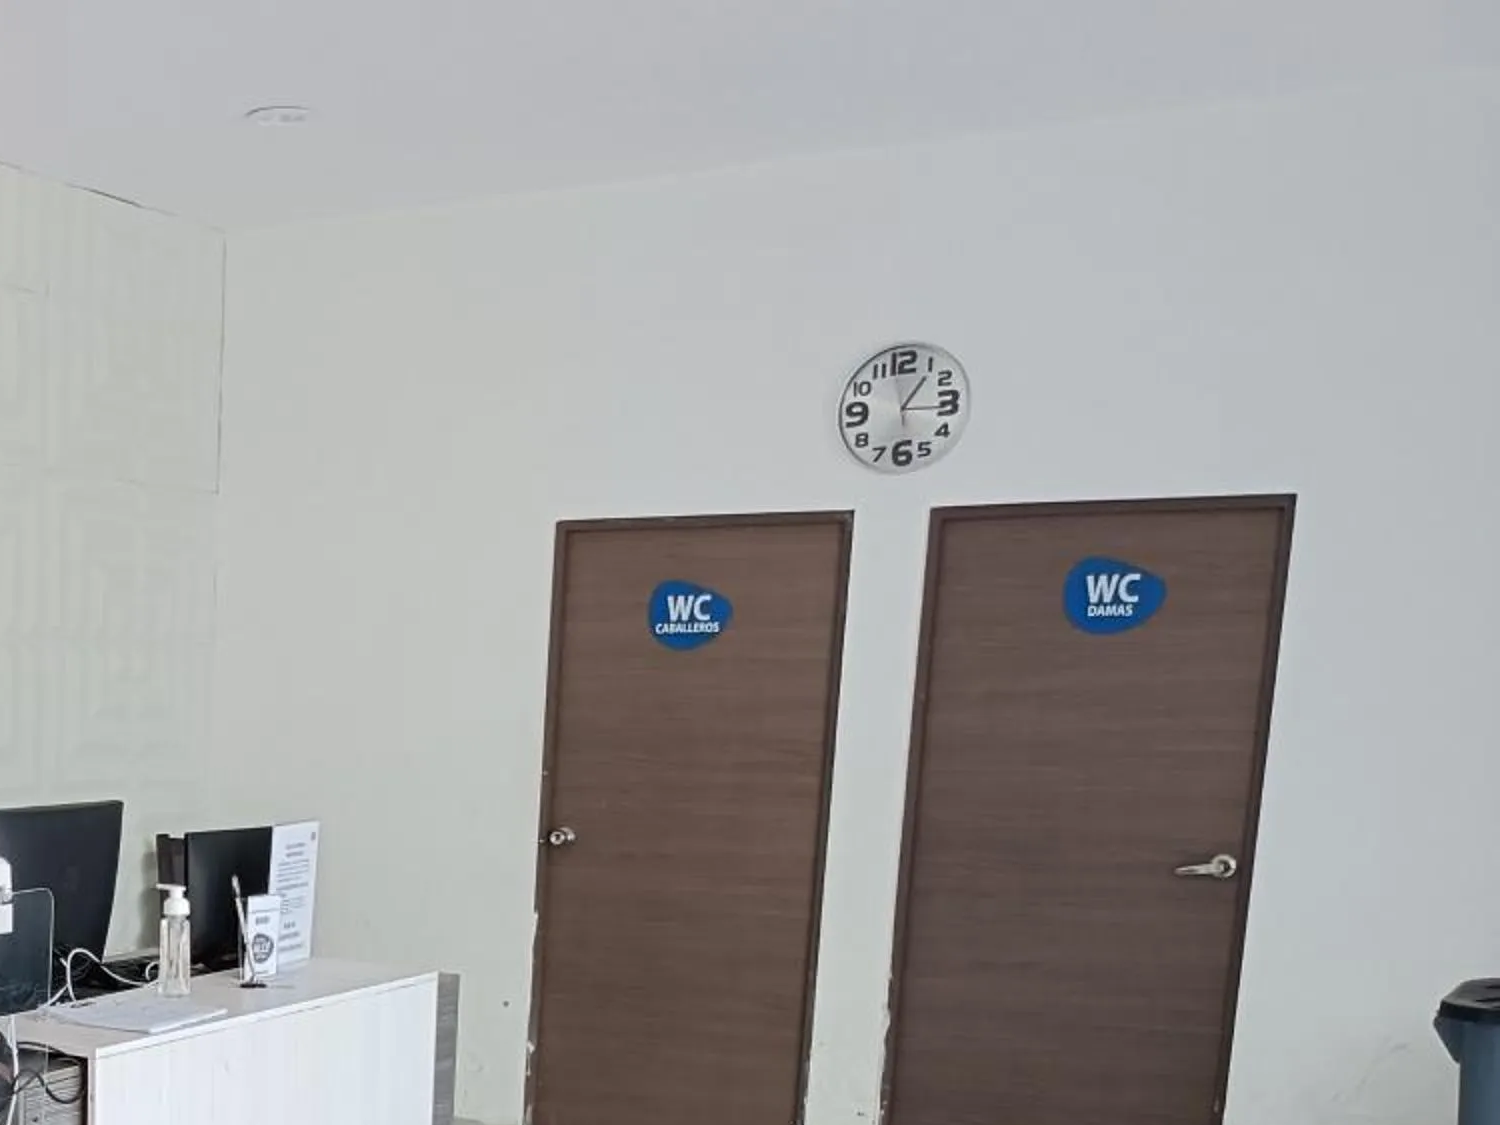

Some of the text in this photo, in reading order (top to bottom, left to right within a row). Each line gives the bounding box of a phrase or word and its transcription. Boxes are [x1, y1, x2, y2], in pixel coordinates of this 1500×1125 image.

[872, 363, 887, 380] 11
[890, 350, 918, 377] 12
[928, 356, 934, 373] 1
[938, 370, 953, 387] 2
[853, 381, 871, 397] 10
[937, 390, 960, 417] 3
[845, 402, 869, 428] 9
[934, 422, 950, 438] 4
[855, 433, 869, 448] 8
[872, 446, 887, 462] 7
[891, 440, 913, 467] 6
[917, 441, 932, 458] 5
[1086, 573, 1141, 604] WC
[667, 594, 712, 621] WC
[1087, 604, 1134, 617] DAMAS
[655, 621, 720, 635] CABALLEROS
